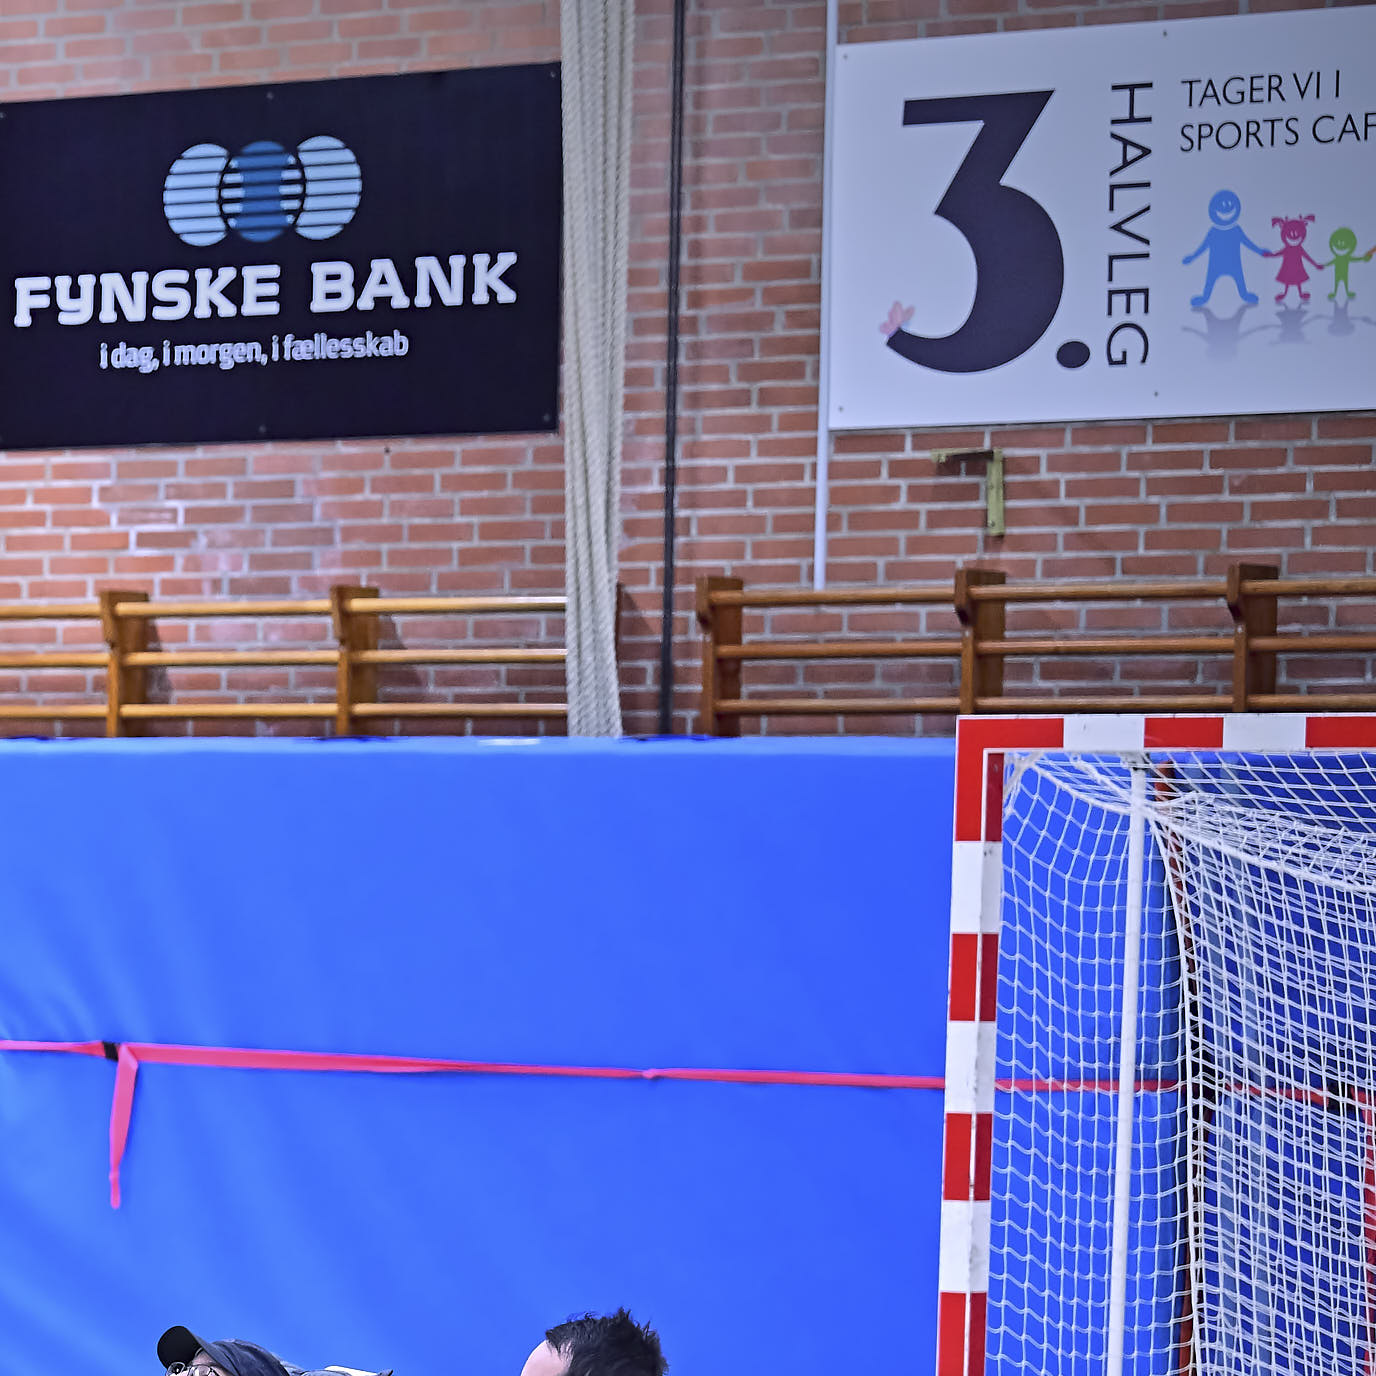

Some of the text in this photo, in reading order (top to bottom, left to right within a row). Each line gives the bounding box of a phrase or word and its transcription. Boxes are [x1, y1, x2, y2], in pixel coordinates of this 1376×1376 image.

[1180, 69, 1341, 108] TAGER VI I
[1179, 117, 1299, 152] SPORTS
[886, 88, 1090, 373] 3.
[1106, 82, 1153, 367] HALVLEG
[13, 251, 519, 328] FYNSKE BANK
[99, 329, 409, 373] i dag, i morgen, i fællesskab
